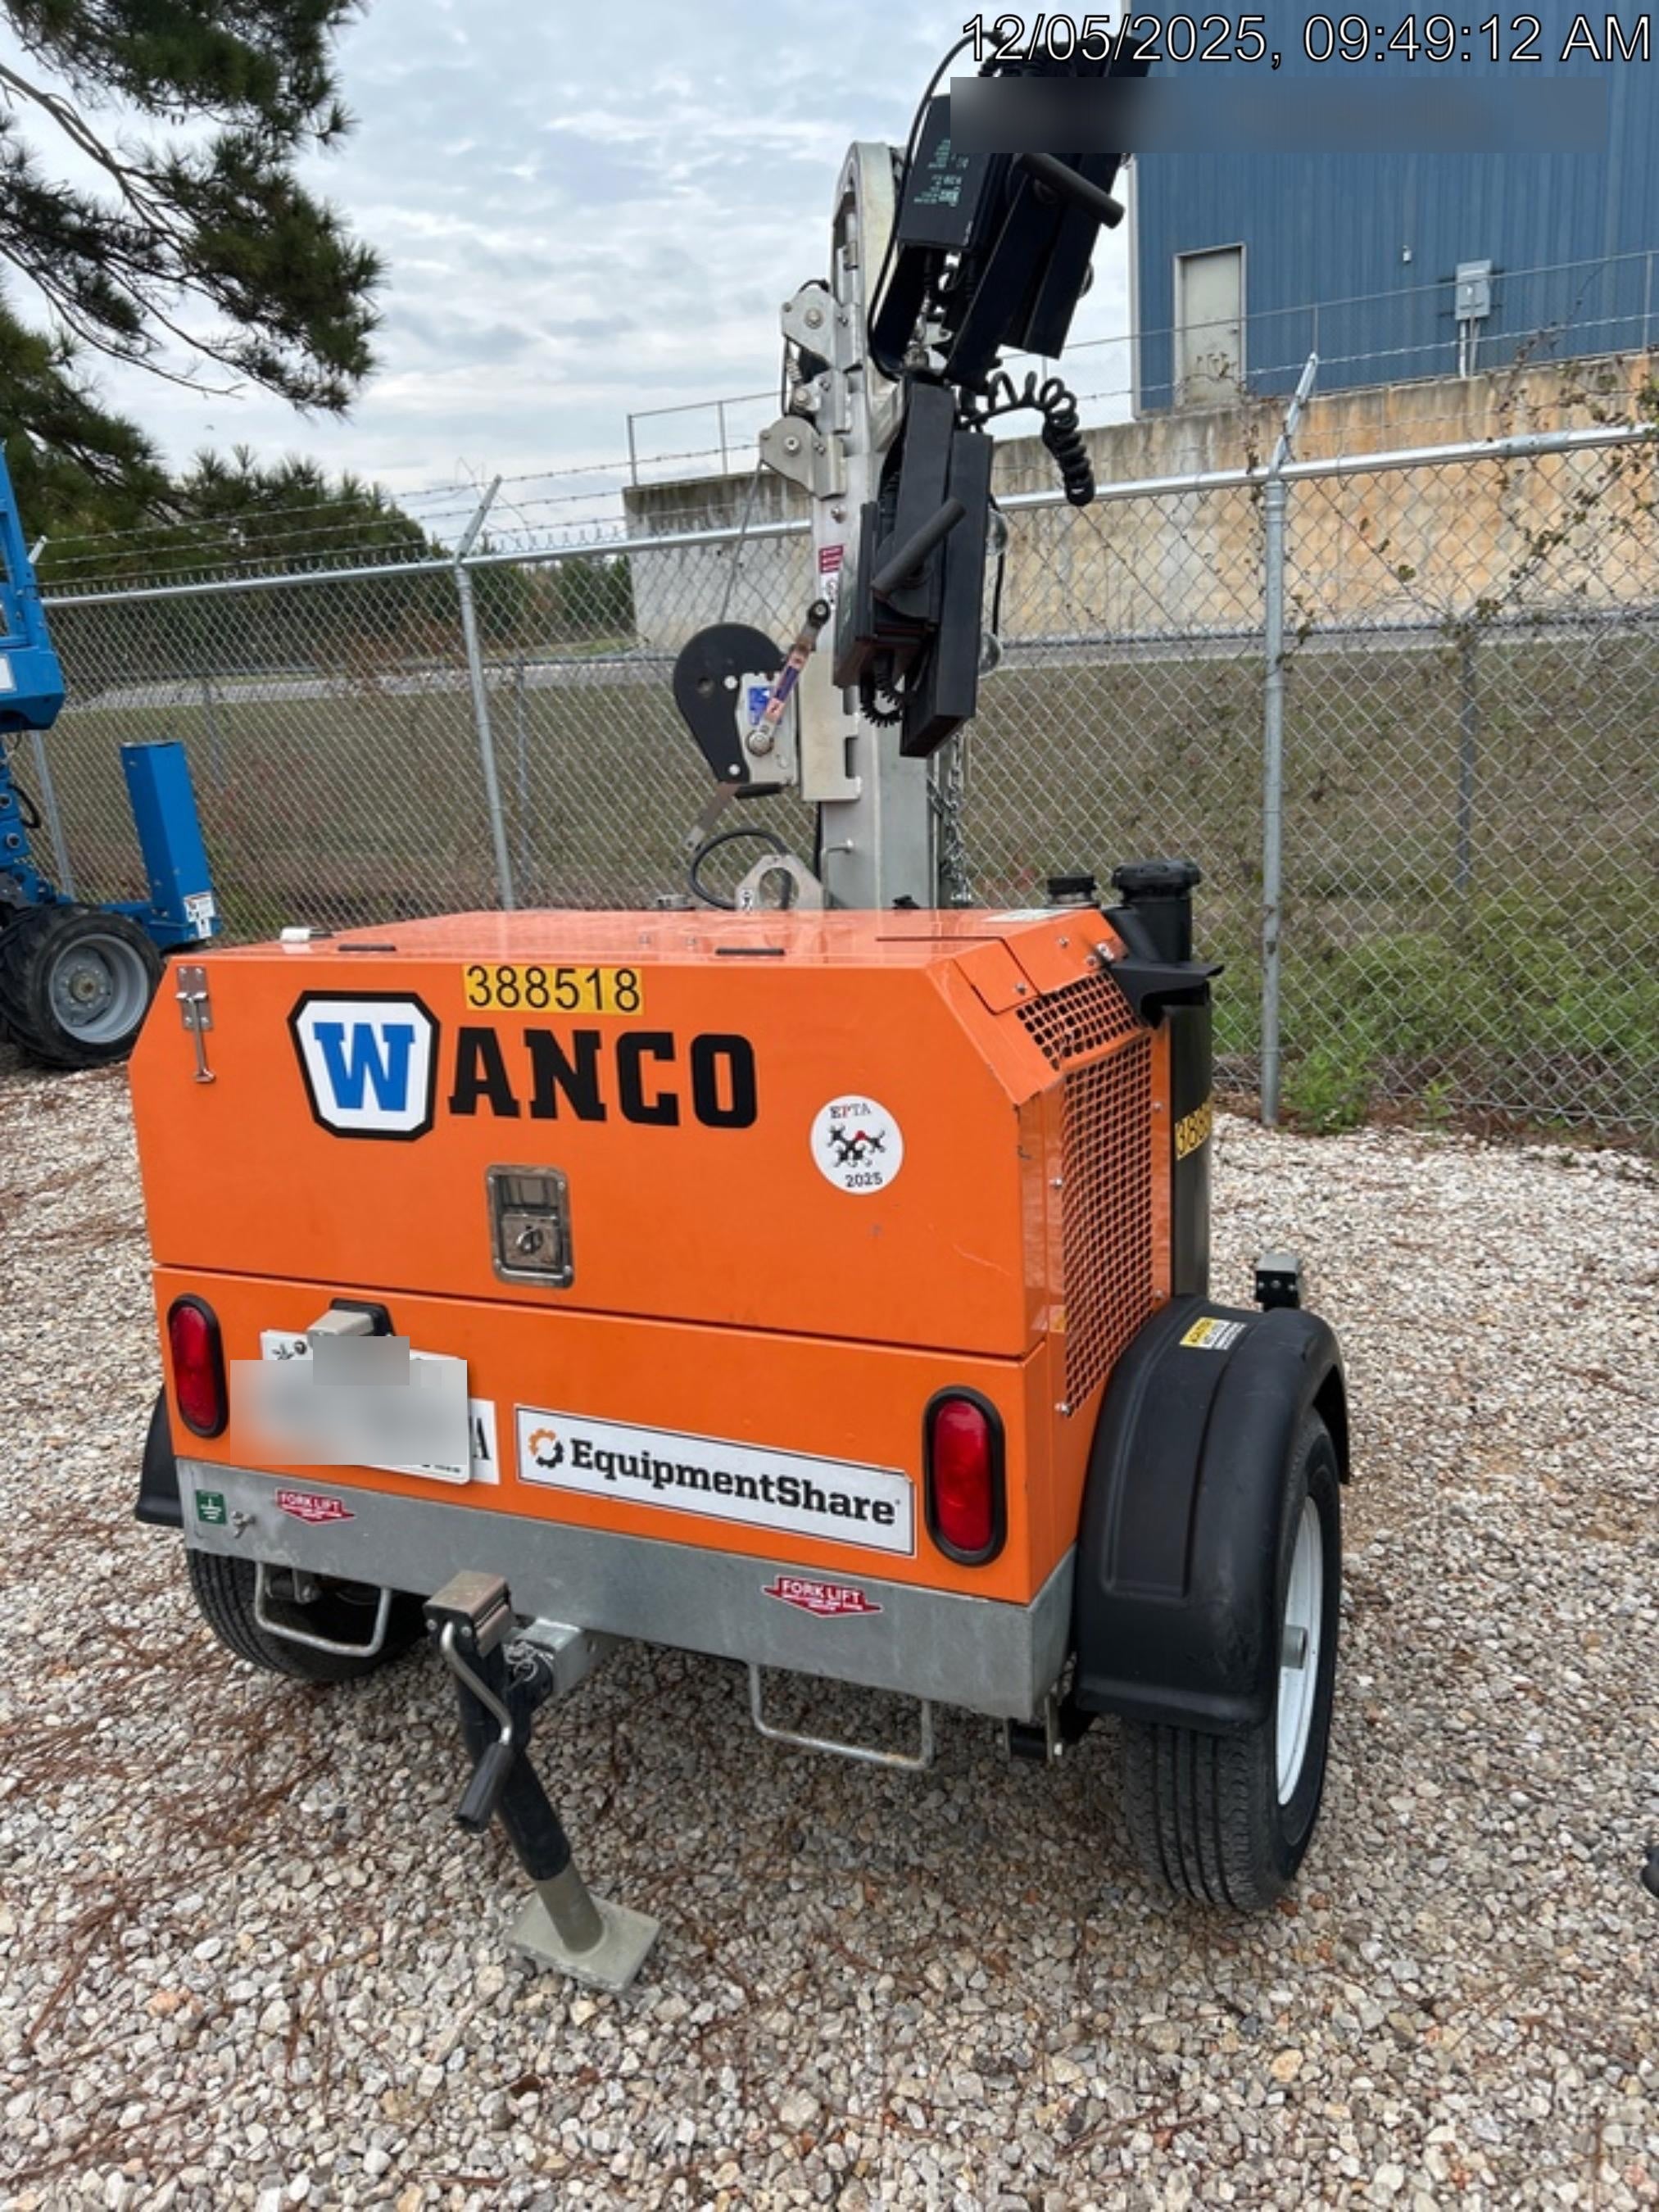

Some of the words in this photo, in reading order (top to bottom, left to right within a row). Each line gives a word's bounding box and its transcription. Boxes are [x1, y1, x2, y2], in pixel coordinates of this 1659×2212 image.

[466, 965, 640, 1013] 388518
[313, 1021, 758, 1129] WANCO
[829, 1103, 872, 1119] EPTA
[845, 1172, 883, 1188] 2025
[570, 1437, 895, 1525] EquipmentShare
[781, 1579, 825, 1599] FORK
[827, 1586, 861, 1605] LIFT
